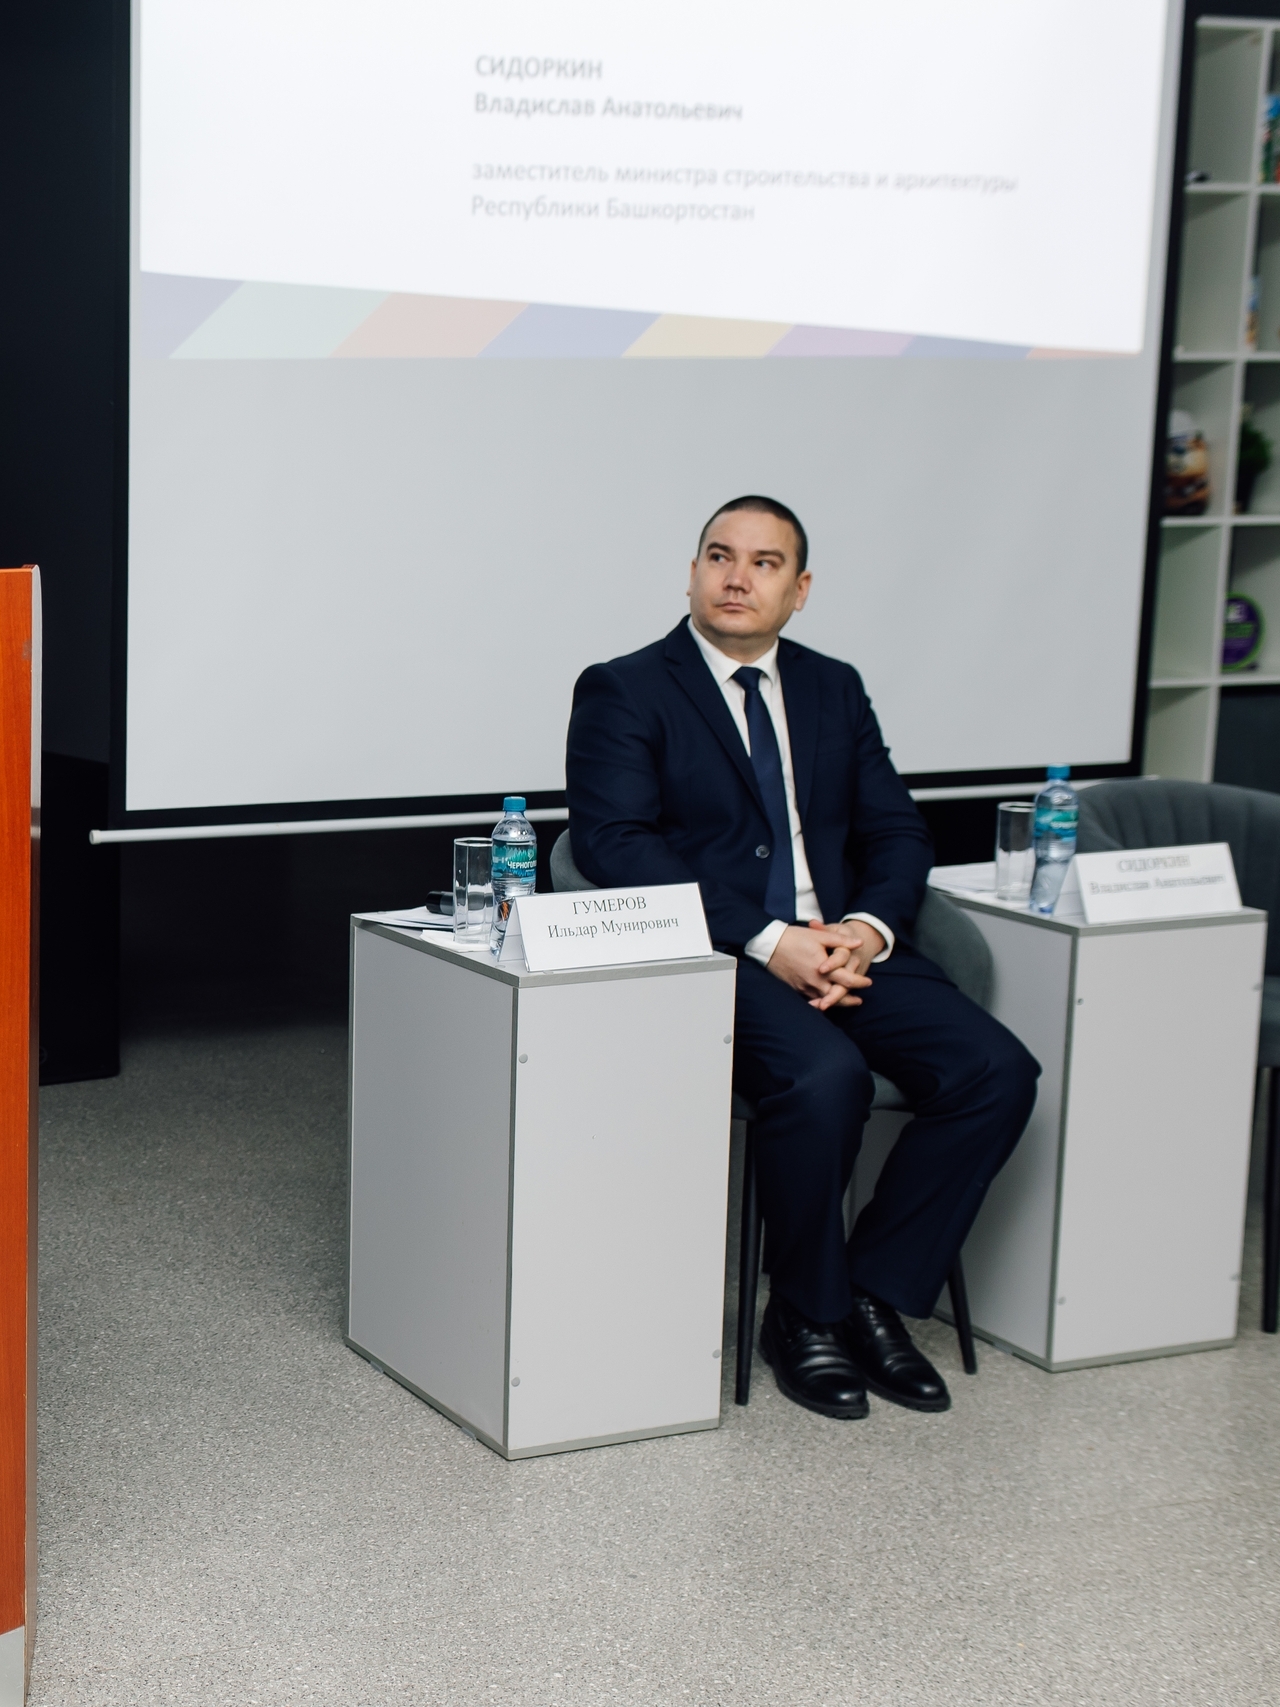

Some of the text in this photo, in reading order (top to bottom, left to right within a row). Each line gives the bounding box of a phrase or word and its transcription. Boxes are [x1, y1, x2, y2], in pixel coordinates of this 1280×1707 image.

[475, 55, 603, 82] СИДОРКИН
[474, 92, 744, 121] Владислав Анатольевич
[471, 162, 1020, 195] заместитель министра строительства и архитектуры
[471, 194, 755, 224] Республики Башкортостан
[572, 896, 647, 915] ГУМЕРОВ
[547, 916, 680, 939] Ильдар Мунирович
